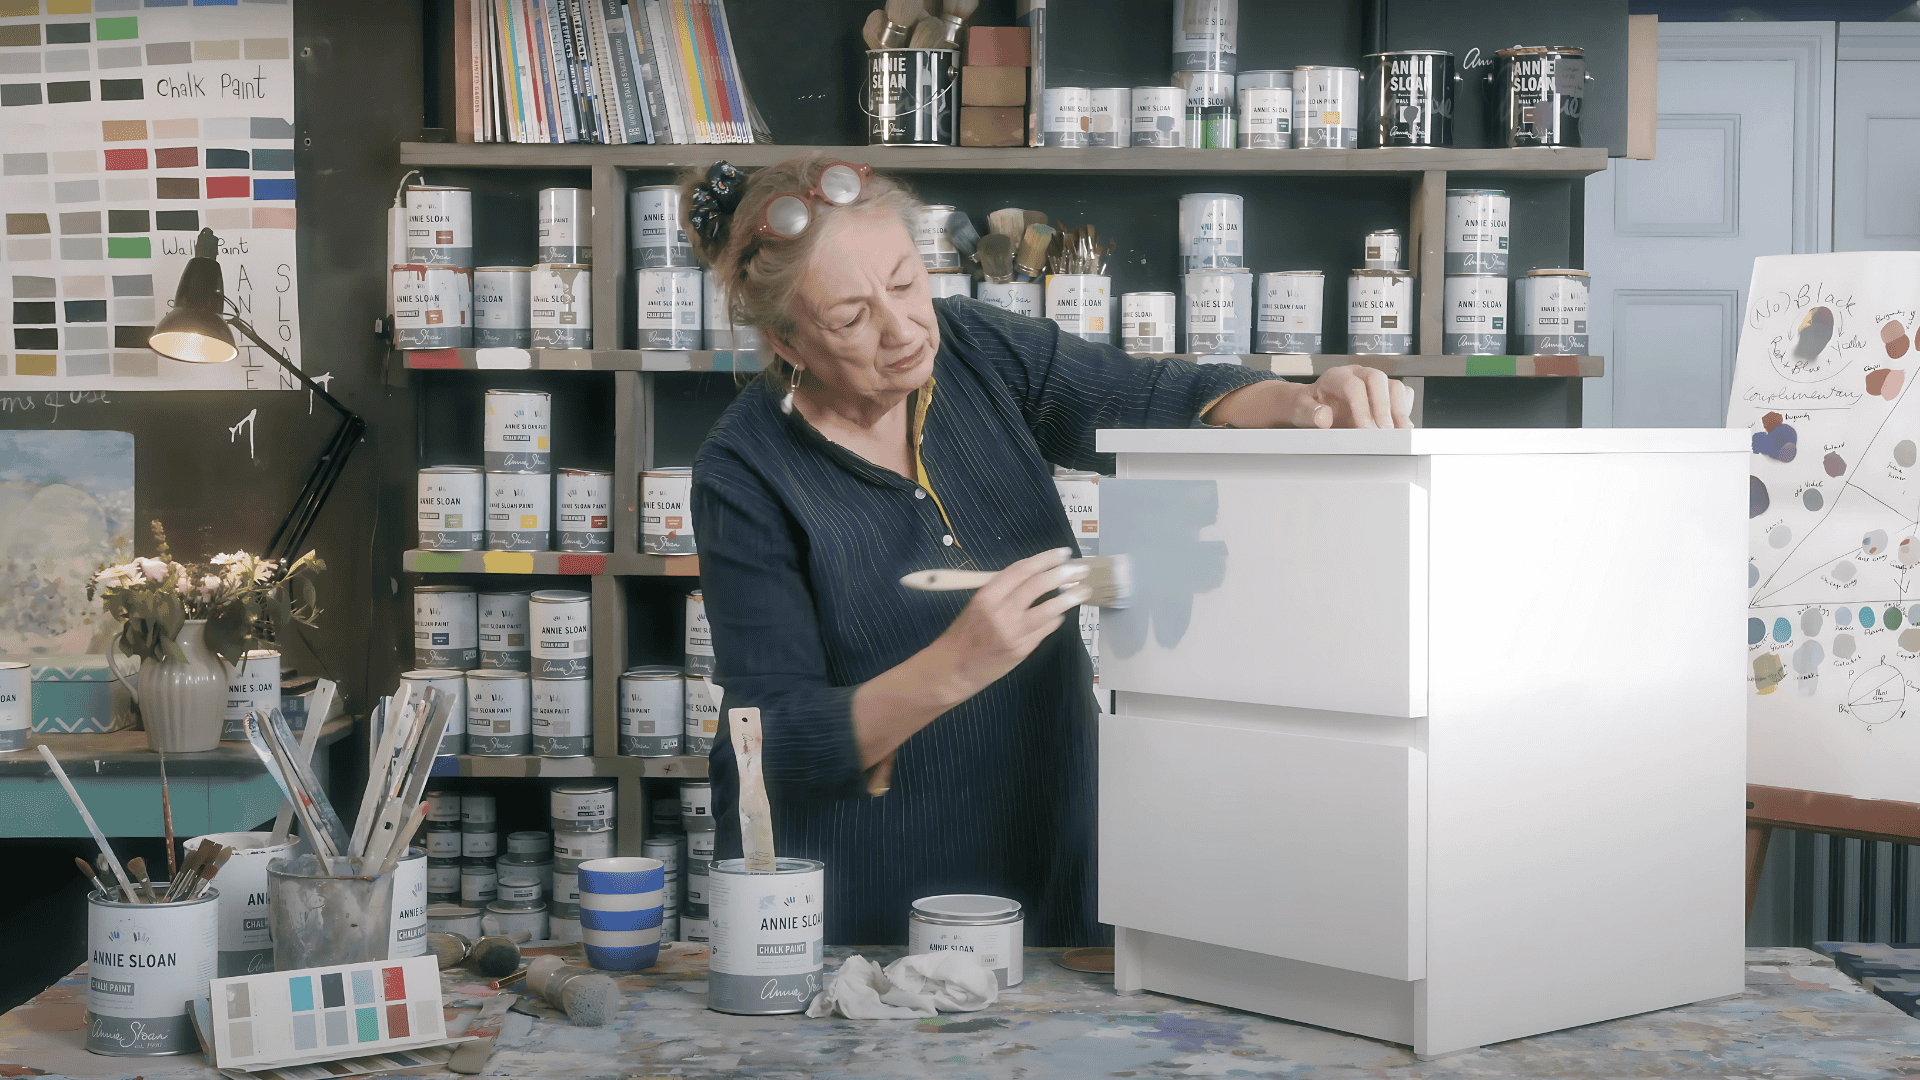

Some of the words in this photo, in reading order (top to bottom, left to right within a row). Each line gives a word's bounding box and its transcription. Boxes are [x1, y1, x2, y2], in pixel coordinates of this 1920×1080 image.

[558, 0, 568, 25] PAINT
[572, 1, 582, 27] PAINT
[561, 26, 574, 59] EFFECTS
[575, 27, 587, 61] EFFECTS
[1513, 60, 1555, 76] ANNE
[157, 70, 207, 99] Chalk
[221, 65, 268, 99] Paint
[873, 74, 906, 88] SLAN
[1390, 76, 1428, 91] SLOA
[623, 82, 631, 99] STYLE
[425, 215, 450, 223] SLOAN
[643, 213, 665, 222] ANNIE
[1464, 219, 1488, 227] ANNIE
[1490, 219, 1507, 228] SLOAN
[162, 237, 196, 256] Wall
[217, 236, 249, 256] Paint
[415, 294, 440, 303] SLOAN
[482, 295, 503, 303] SLOAN
[1056, 299, 1078, 307] ANNIE
[1191, 300, 1211, 308] ANNIE
[1351, 300, 1369, 309] ANNIE
[1370, 300, 1395, 309] SLOAN
[1482, 300, 1503, 309] SLOAN
[1794, 282, 1857, 318] Black
[237, 264, 264, 390] ANIE
[1791, 360, 1821, 375] Blue
[436, 497, 461, 505] SLOAN
[657, 502, 681, 510] SLOAN
[1069, 505, 1093, 513] SLOAN
[541, 626, 563, 635] ANNIE
[565, 625, 587, 635] SLOAN
[228, 684, 247, 693] NNIE
[249, 683, 273, 693] SOAN
[0, 694, 17, 703] OAN
[695, 704, 718, 713] SLOAN
[399, 906, 419, 919] ANNIE
[760, 916, 799, 931] ANNIE
[759, 945, 784, 955] CHALK
[785, 943, 805, 954] PAINT
[929, 943, 949, 951] ANNIE
[93, 949, 125, 968] ANNIE
[129, 952, 177, 968] SLOAN
[109, 983, 132, 994] PAINT
[760, 978, 803, 1000] Annie
[91, 1018, 124, 1041] Annie
[119, 1021, 169, 1048] Sloan
